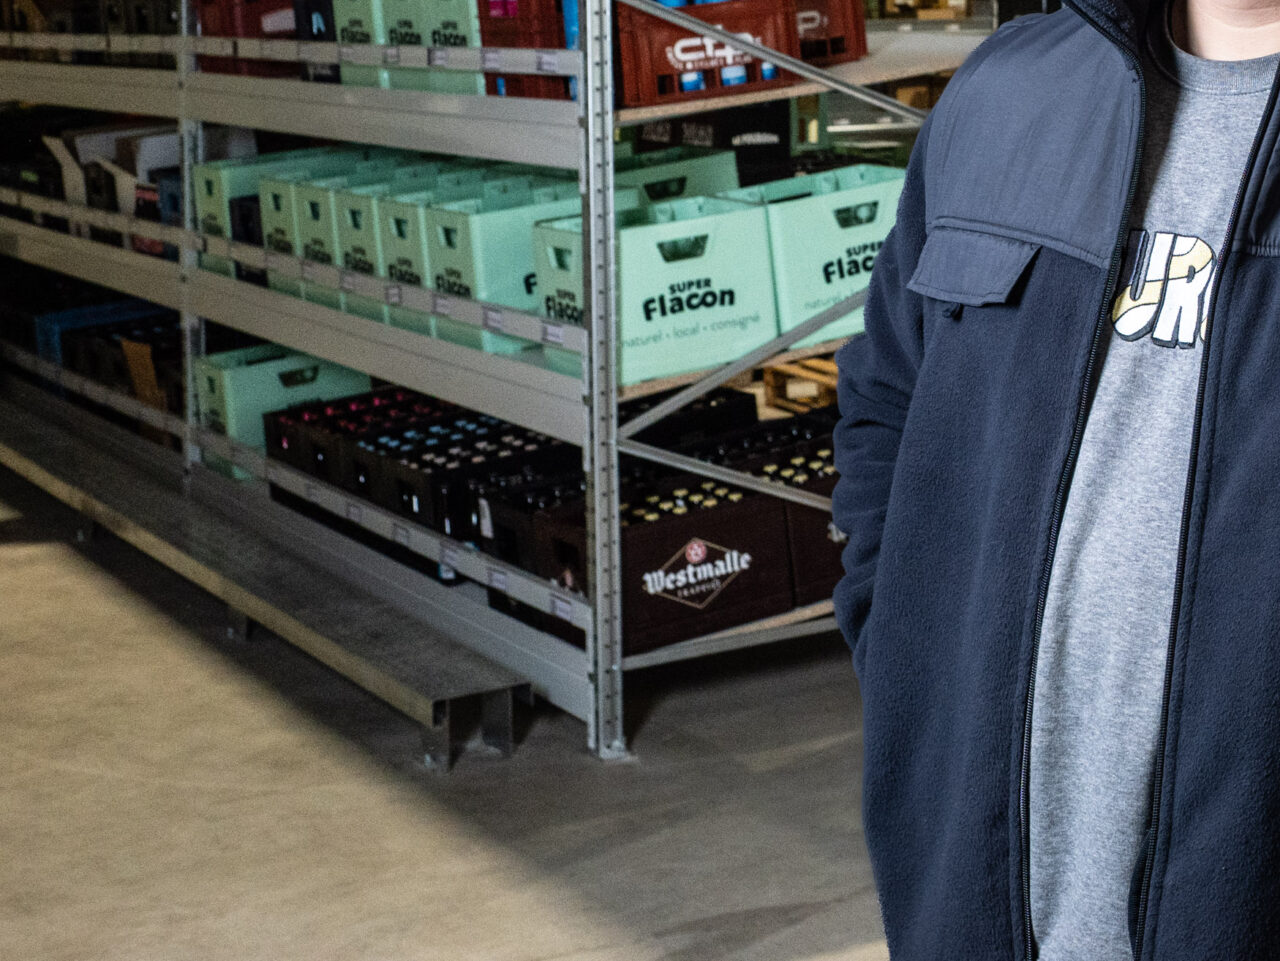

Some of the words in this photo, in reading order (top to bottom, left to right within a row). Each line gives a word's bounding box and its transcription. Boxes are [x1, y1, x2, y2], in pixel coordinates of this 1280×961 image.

[846, 240, 884, 257] SUPE
[823, 253, 874, 284] Flac
[669, 278, 711, 294] SUPER
[1111, 229, 1217, 350] UR
[642, 288, 735, 321] Flacon
[643, 550, 752, 595] Westmalle
